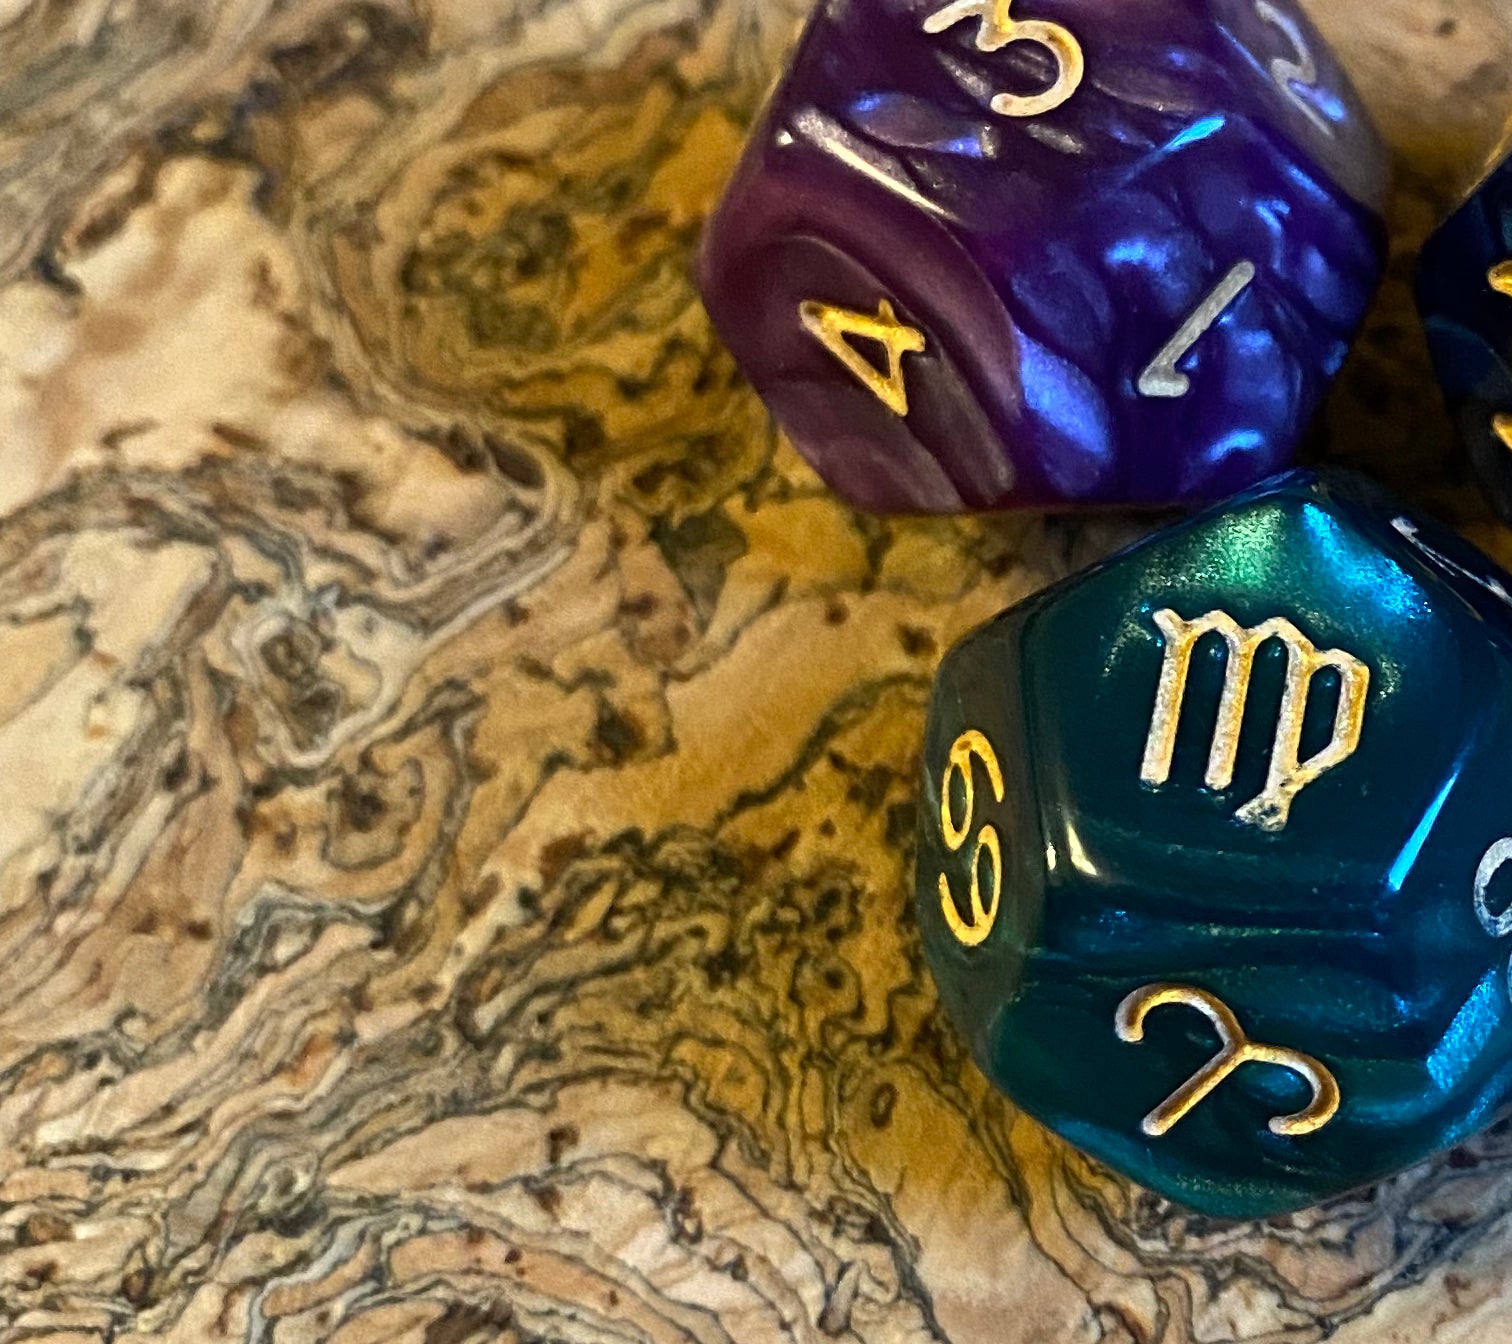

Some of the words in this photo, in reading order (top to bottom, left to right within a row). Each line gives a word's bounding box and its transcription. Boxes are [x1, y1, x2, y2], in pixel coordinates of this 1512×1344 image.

[1254, 0, 1336, 137] 2
[800, 299, 925, 417] 4
[1137, 261, 1256, 398] 1
